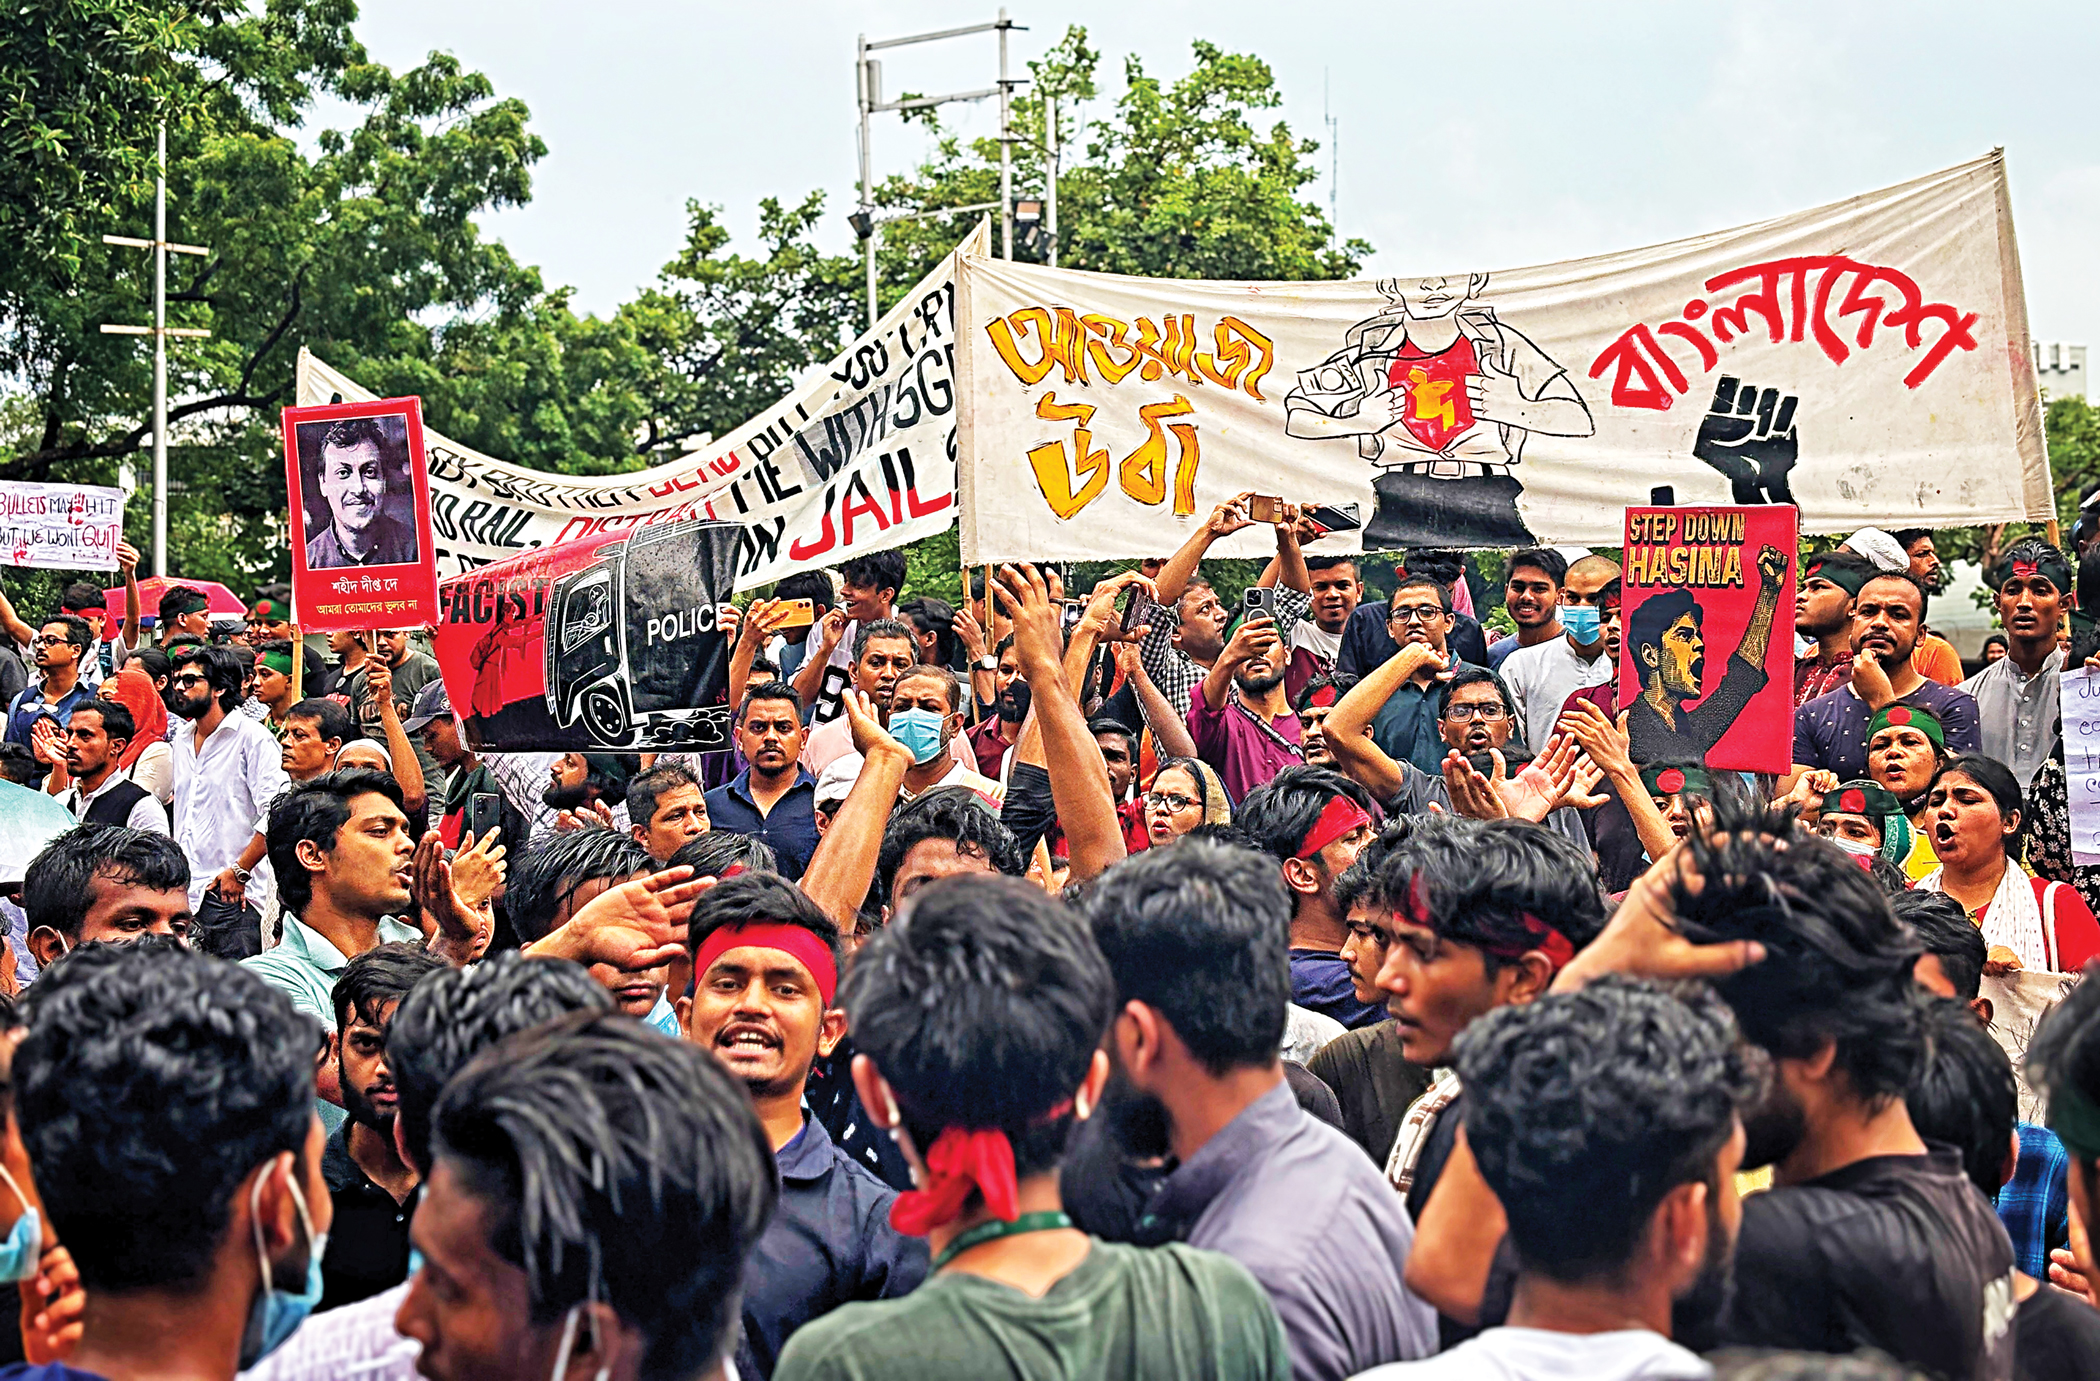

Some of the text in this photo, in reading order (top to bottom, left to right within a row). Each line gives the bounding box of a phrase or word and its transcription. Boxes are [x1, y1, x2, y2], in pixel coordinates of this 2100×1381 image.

[1588, 255, 1979, 411] বাংলাদেশ
[794, 384, 891, 482] WITH
[85, 498, 117, 516] HIT
[789, 446, 952, 561] JAIL
[23, 527, 44, 547] WE
[82, 524, 120, 555] QUIT
[1629, 512, 1747, 544] STEP DOWN
[1626, 545, 1745, 588] HASINA
[331, 576, 359, 595] শহীদ
[383, 578, 399, 592] দে
[316, 604, 343, 615] আমরা
[344, 602, 383, 615] তোমাদের
[407, 599, 418, 610] না
